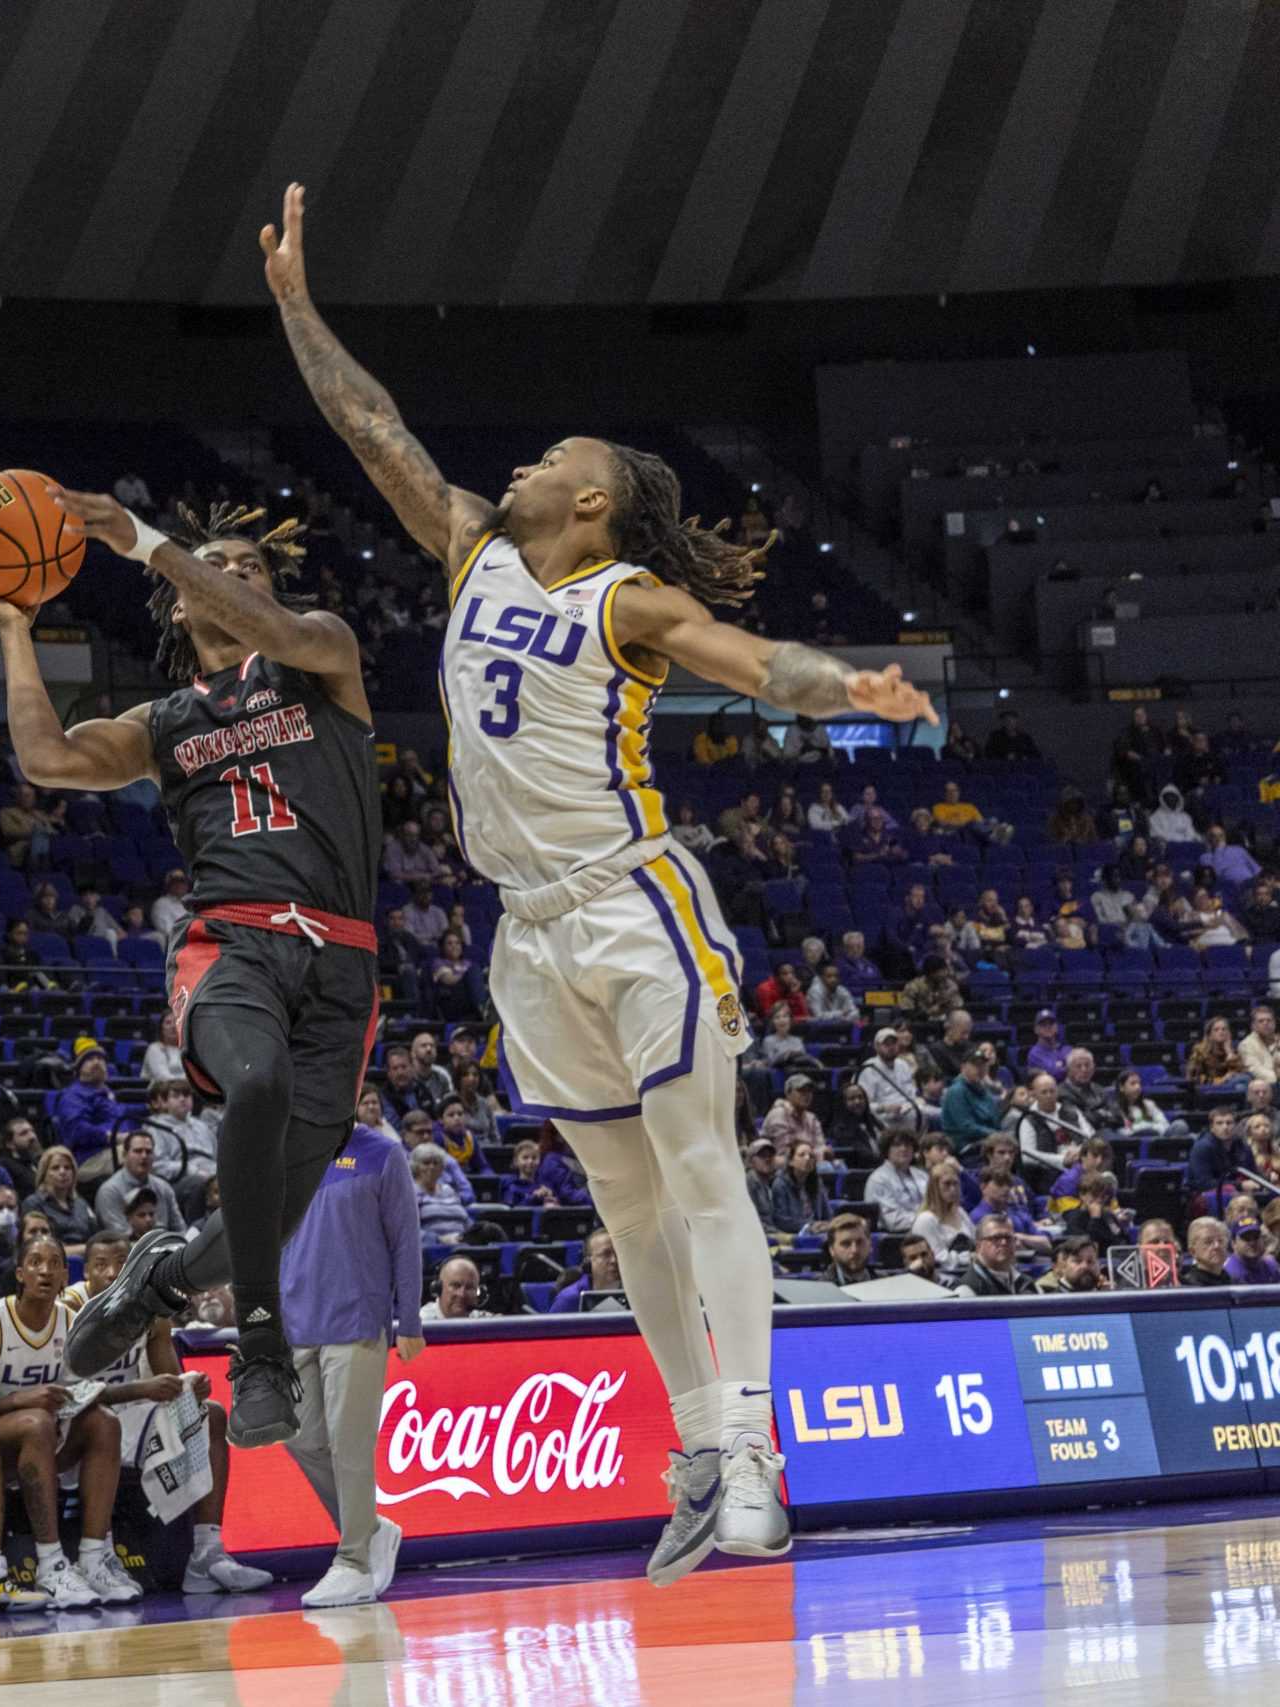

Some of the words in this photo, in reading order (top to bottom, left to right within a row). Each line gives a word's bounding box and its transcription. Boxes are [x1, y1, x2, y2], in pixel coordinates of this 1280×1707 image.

[461, 597, 586, 665] LSU
[479, 660, 523, 738] 3
[251, 704, 314, 750] STATE
[220, 762, 298, 837] 11
[1032, 1335, 1068, 1353] TIME
[1069, 1332, 1109, 1352] OUTS
[1, 1363, 61, 1386] LSU
[788, 1384, 904, 1443] LSU
[935, 1373, 993, 1437] 15
[1045, 1418, 1088, 1437] TEAM
[378, 1369, 626, 1496] Coca-Cola
[1050, 1441, 1098, 1461] FOULS
[1101, 1420, 1121, 1452] 3
[1213, 1422, 1280, 1452] PERIOD
